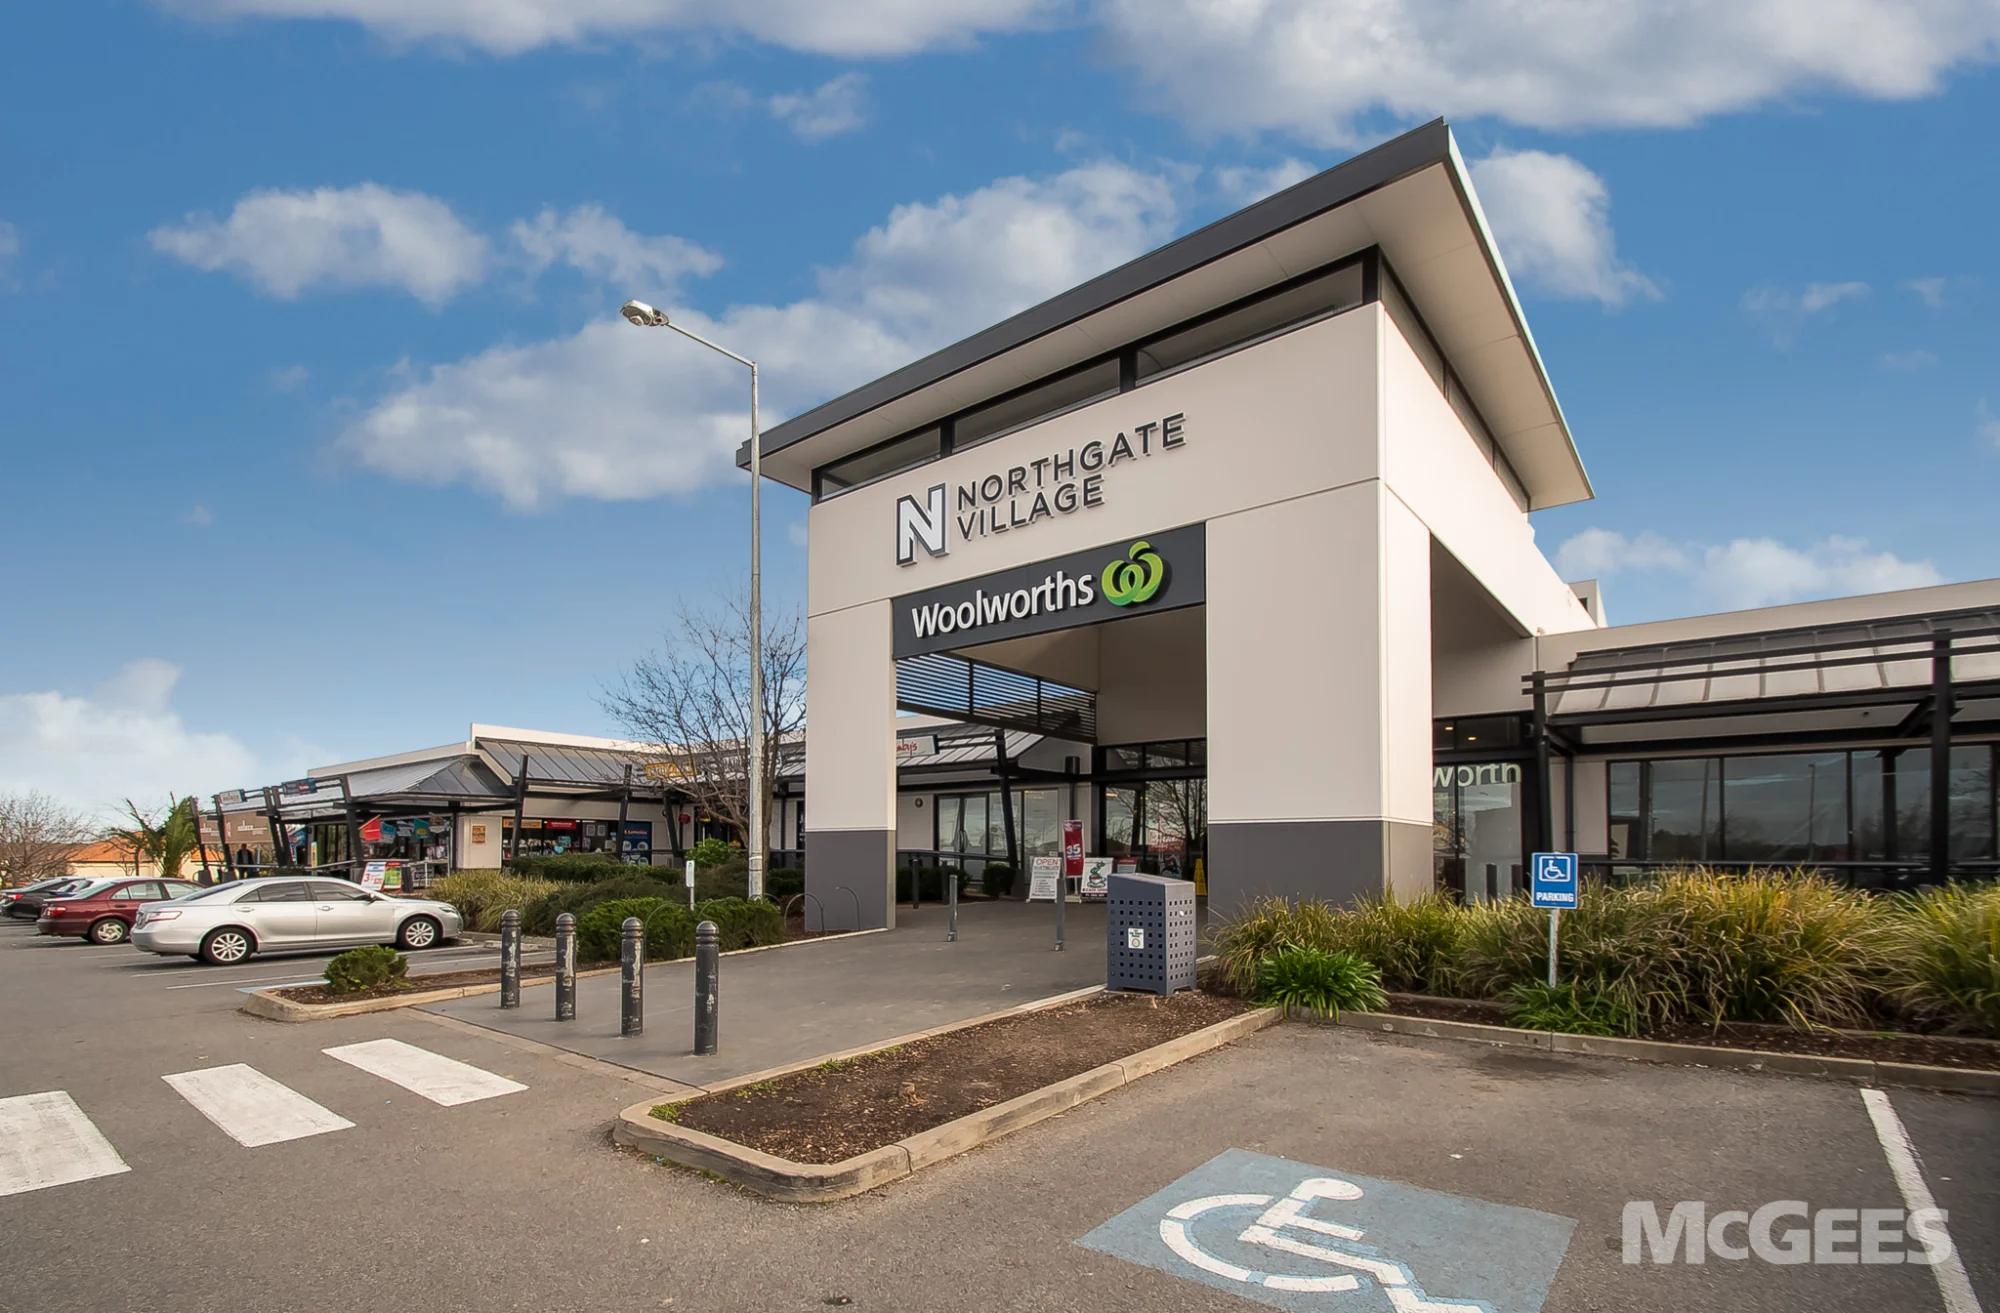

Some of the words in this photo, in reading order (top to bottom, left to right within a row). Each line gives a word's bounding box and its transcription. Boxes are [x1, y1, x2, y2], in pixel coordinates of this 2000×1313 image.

[957, 411, 1186, 511] NORTHGATE
[896, 482, 949, 567] N
[957, 473, 1105, 541] VILLAGE
[911, 570, 1095, 639] Woolworths
[1066, 843, 1081, 854] 35
[1536, 892, 1574, 902] PARKING
